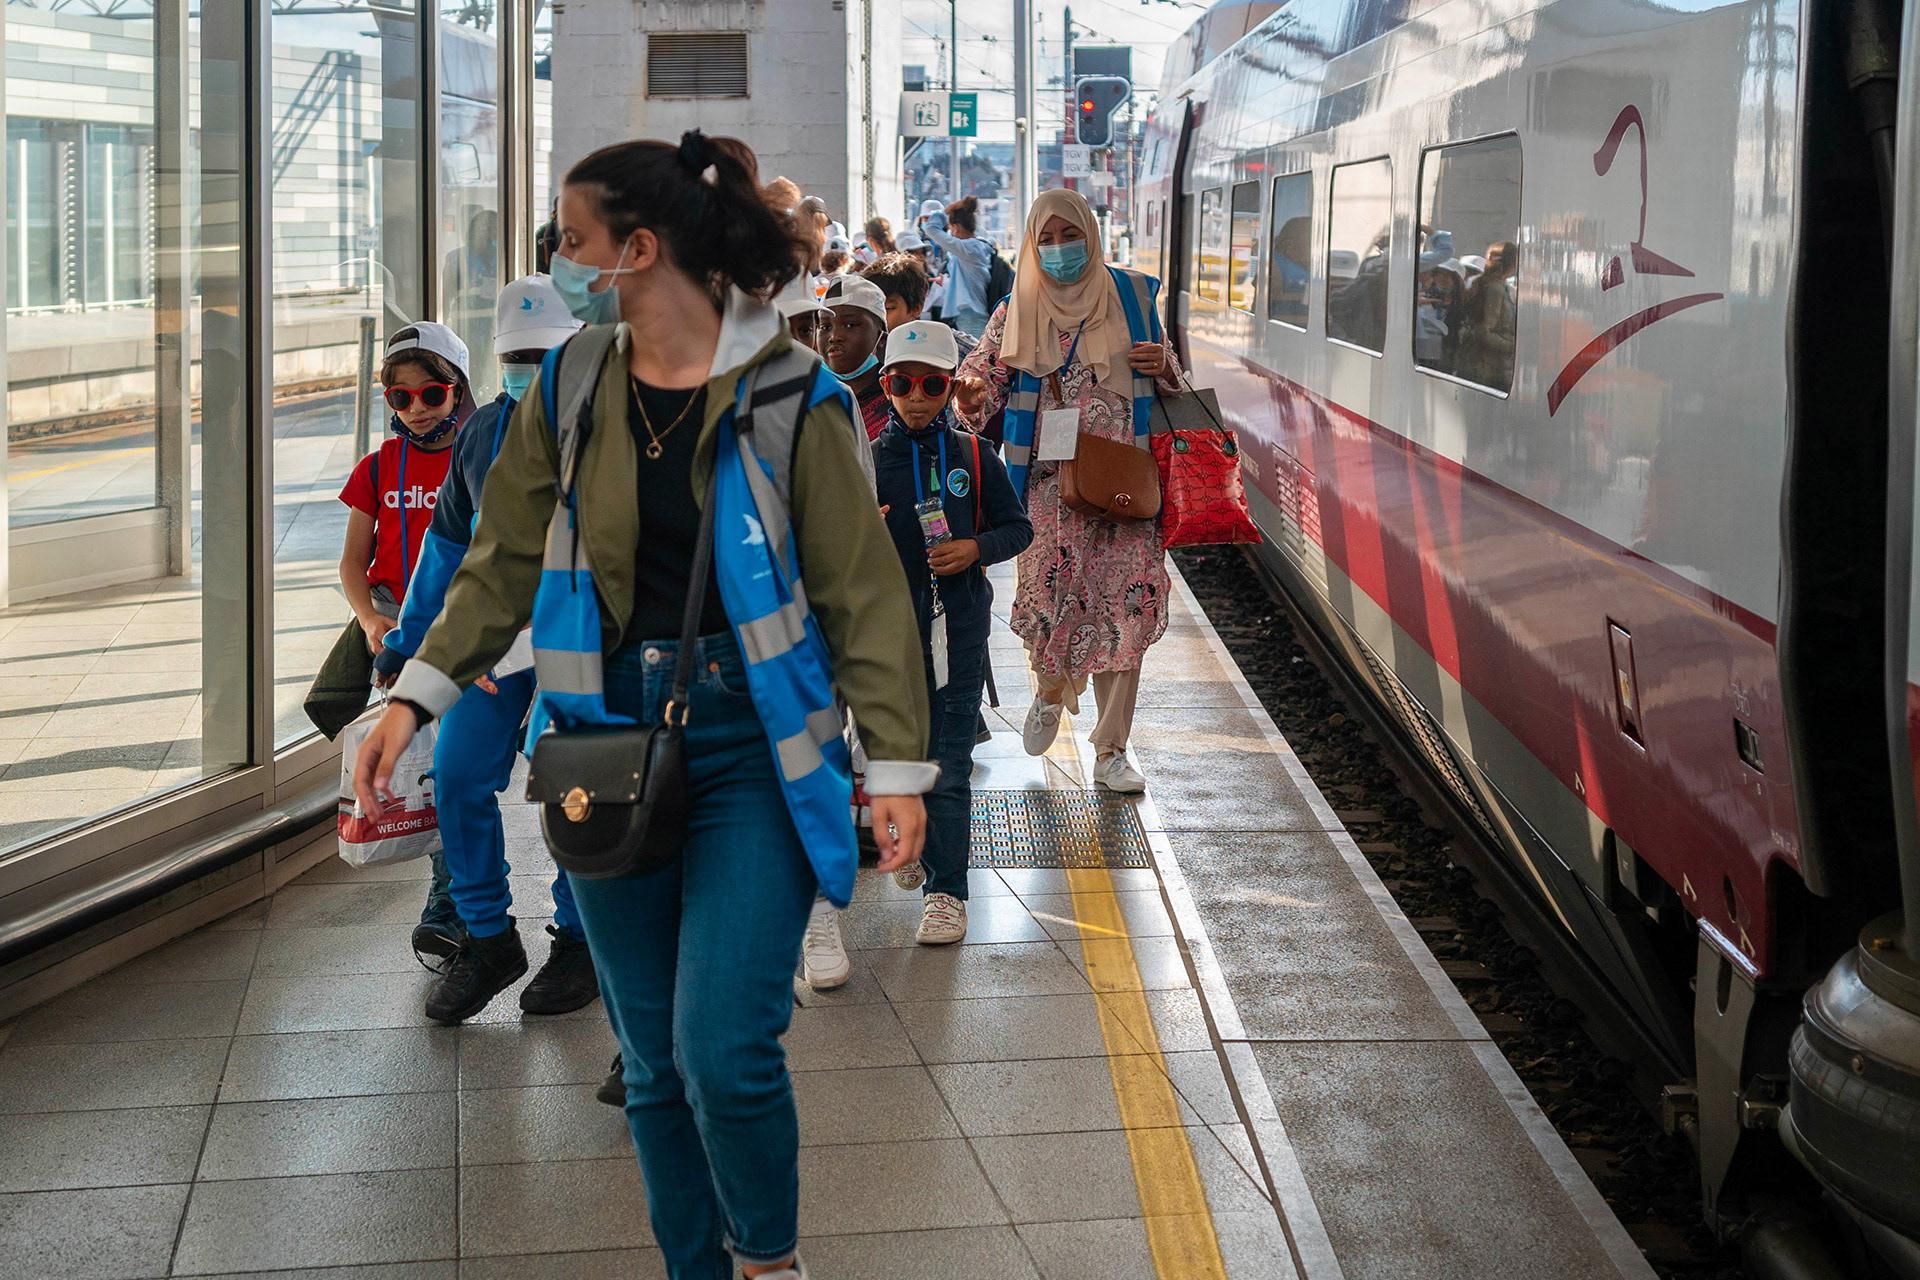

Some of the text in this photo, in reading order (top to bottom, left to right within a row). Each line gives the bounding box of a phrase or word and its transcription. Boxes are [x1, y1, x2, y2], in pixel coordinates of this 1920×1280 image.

[1064, 150, 1081, 159] TGV
[1064, 163, 1081, 172] TGV
[377, 819, 422, 834] WELCOME
